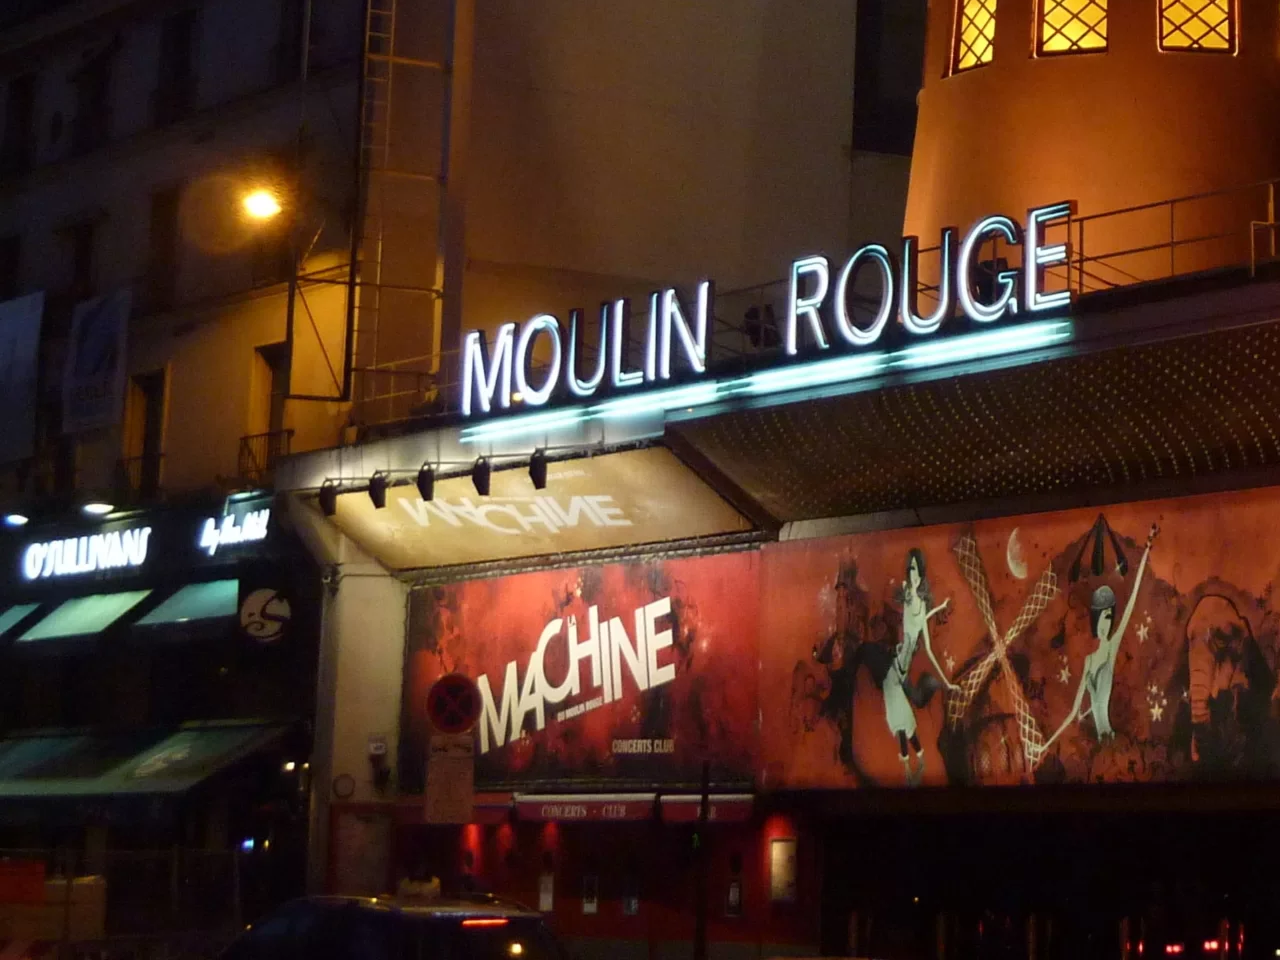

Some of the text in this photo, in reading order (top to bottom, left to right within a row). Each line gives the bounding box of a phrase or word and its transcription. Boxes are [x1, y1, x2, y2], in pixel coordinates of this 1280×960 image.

[461, 201, 1075, 417] MOULIN ROUGE
[477, 596, 676, 755] MACHINE
[611, 738, 675, 754] CONCERTS CLUB
